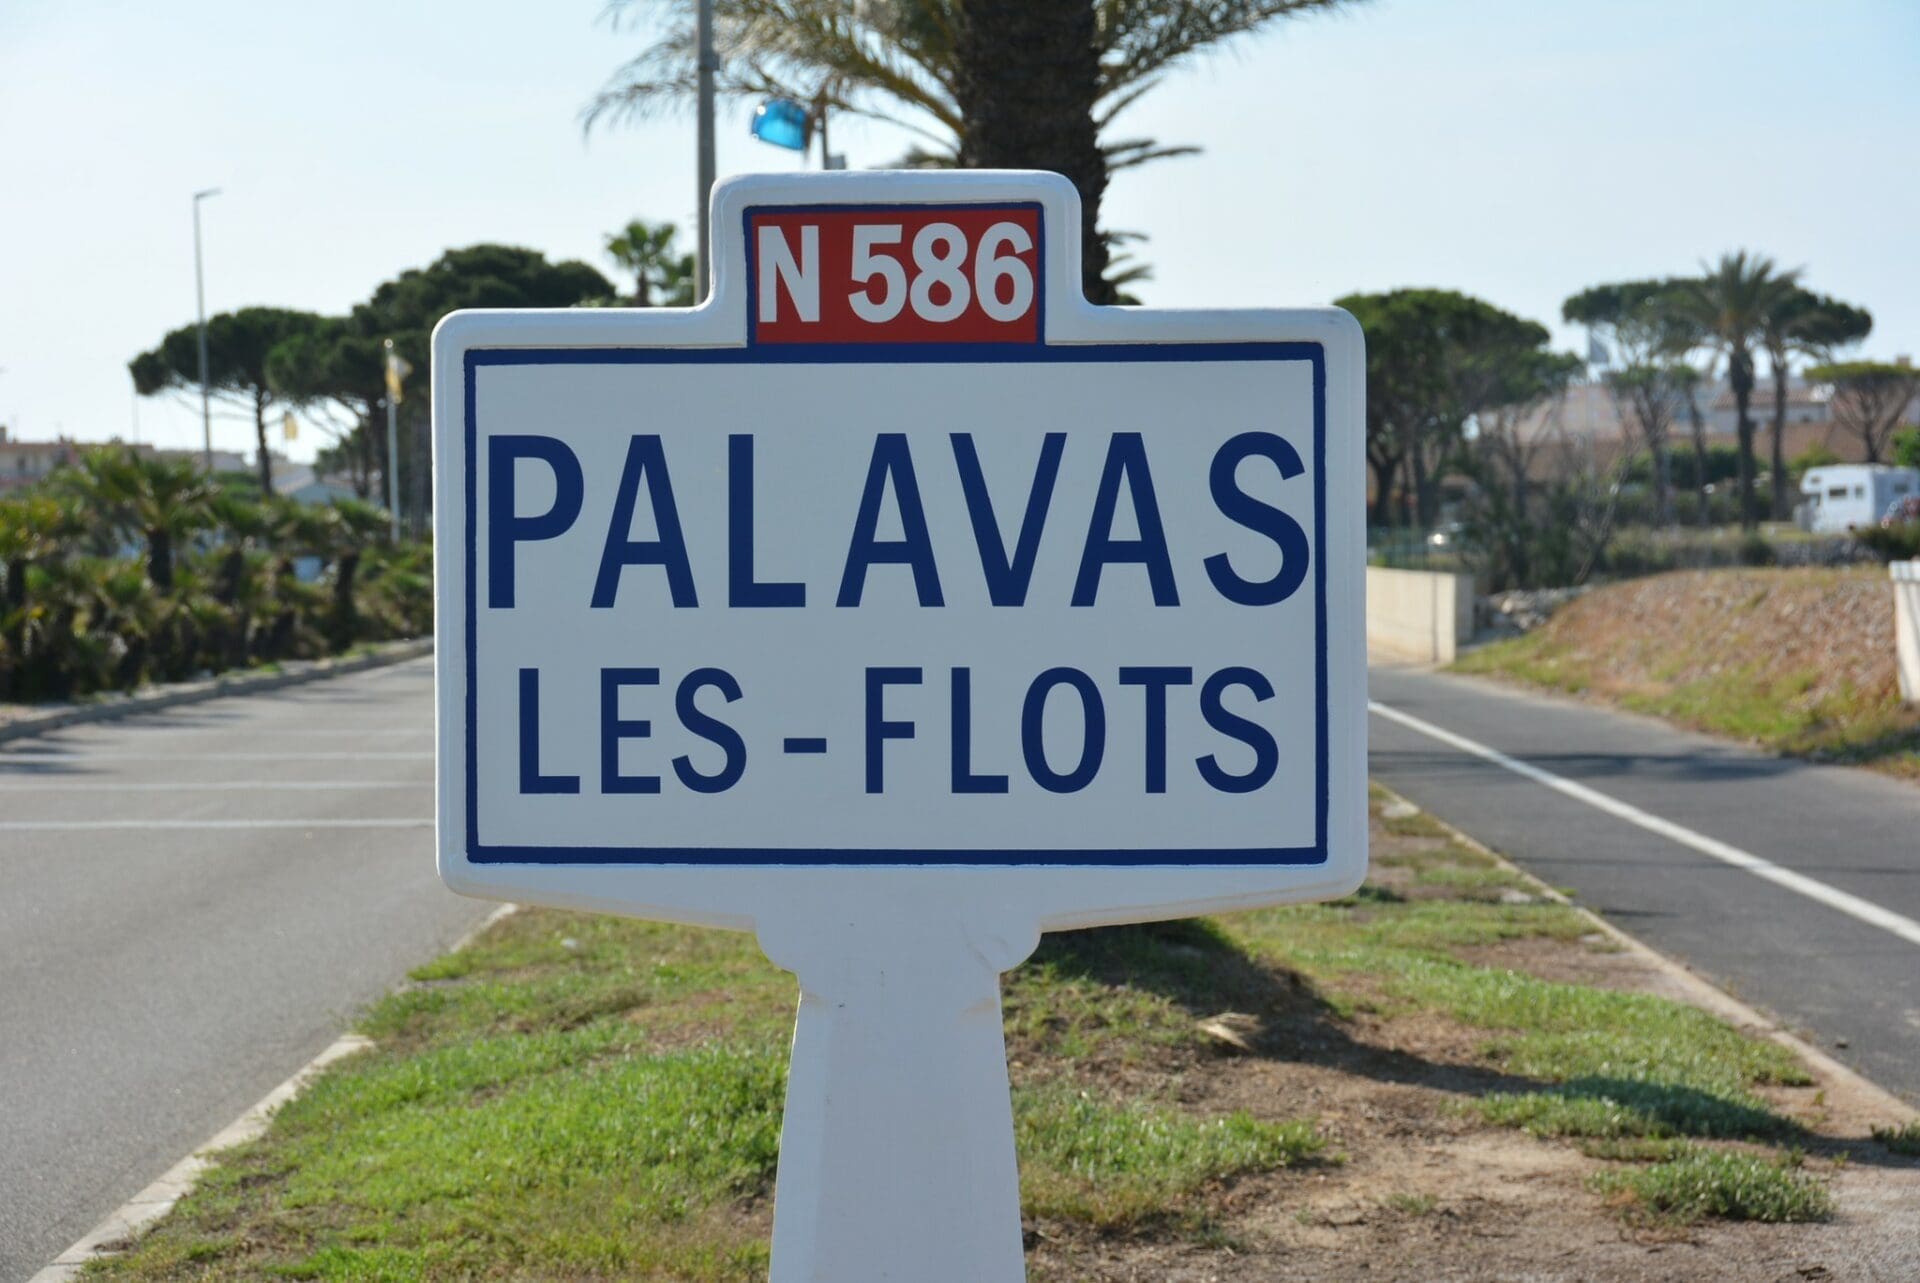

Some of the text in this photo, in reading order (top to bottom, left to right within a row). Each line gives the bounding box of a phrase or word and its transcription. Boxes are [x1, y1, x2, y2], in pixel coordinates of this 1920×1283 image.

[759, 222, 1033, 322] N 586
[488, 431, 1310, 609] PALAVAS
